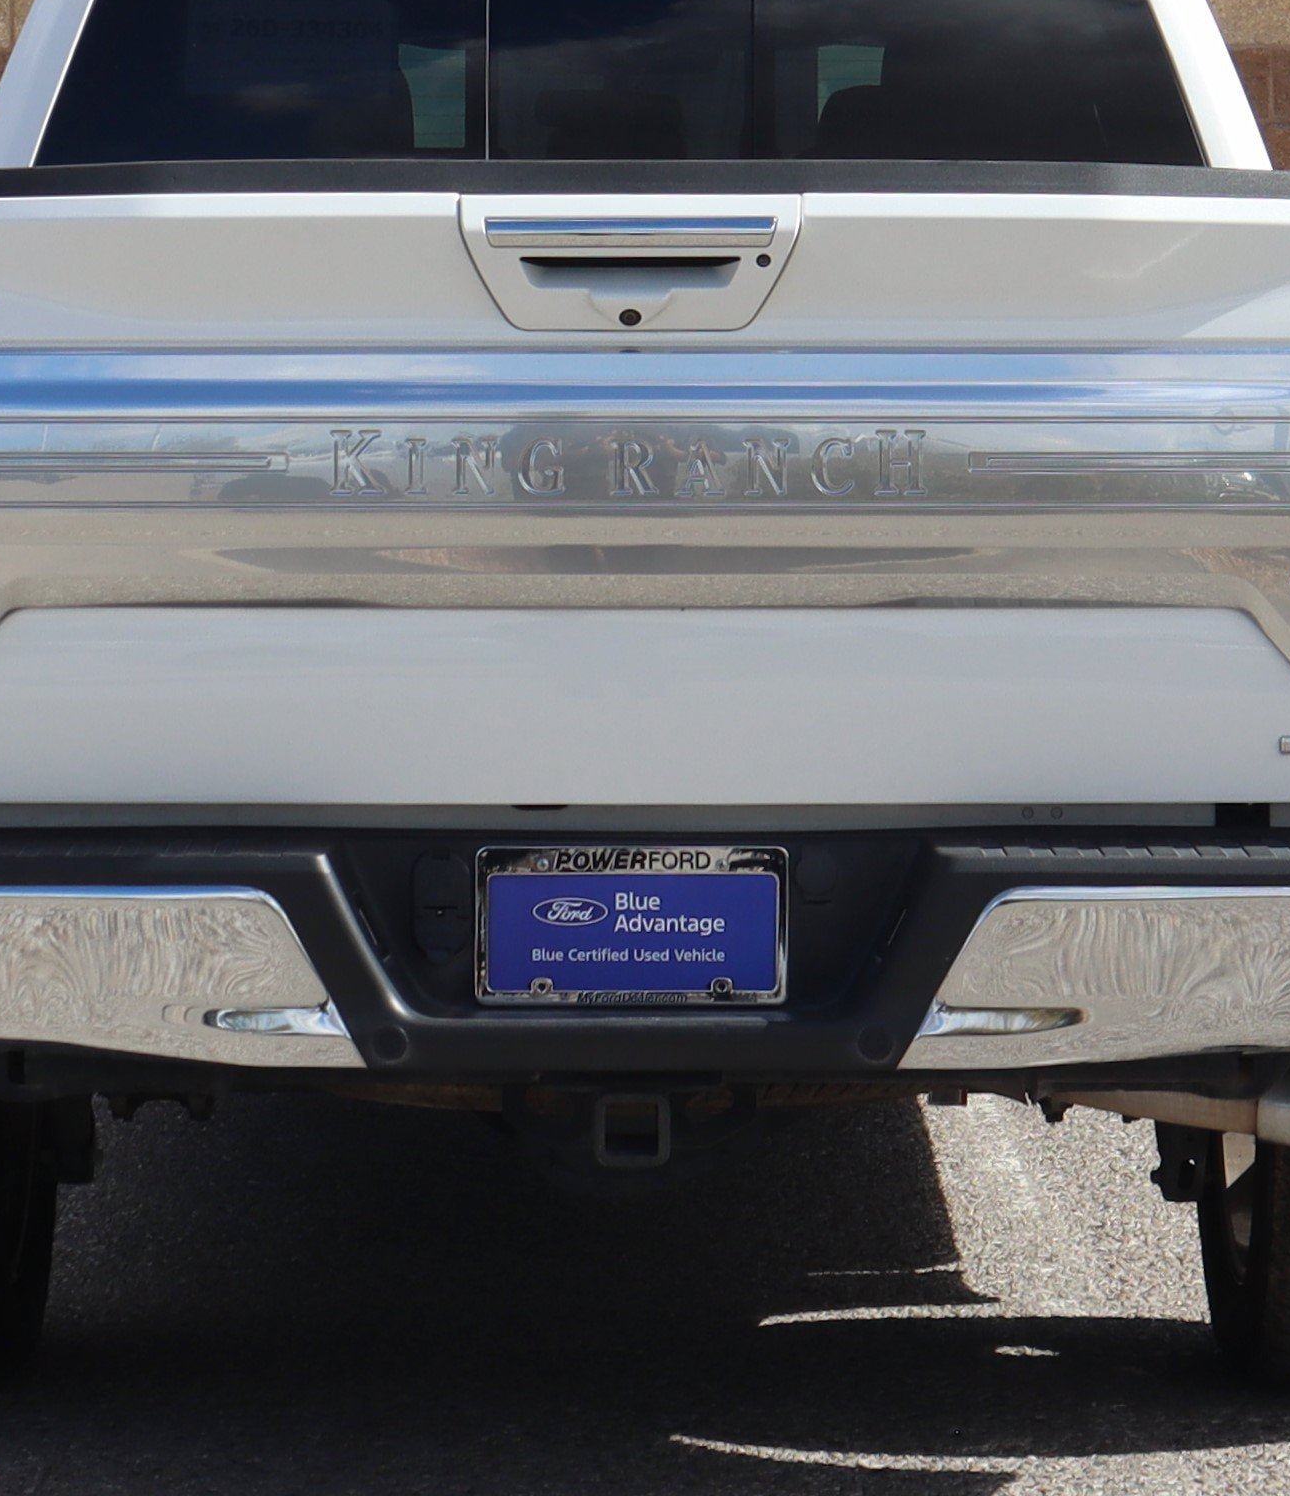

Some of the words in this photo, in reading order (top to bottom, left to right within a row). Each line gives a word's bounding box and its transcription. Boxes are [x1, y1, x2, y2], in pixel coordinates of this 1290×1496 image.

[329, 428, 567, 496] KING
[608, 427, 928, 497] RANCH
[554, 851, 712, 871] POWERFORD
[546, 900, 595, 922] Ford
[614, 892, 661, 911] Blue
[614, 913, 726, 936] Advantage
[531, 948, 564, 962] Blue
[568, 948, 629, 962] Certified
[633, 948, 670, 962] Used
[674, 948, 726, 962] Vehicle
